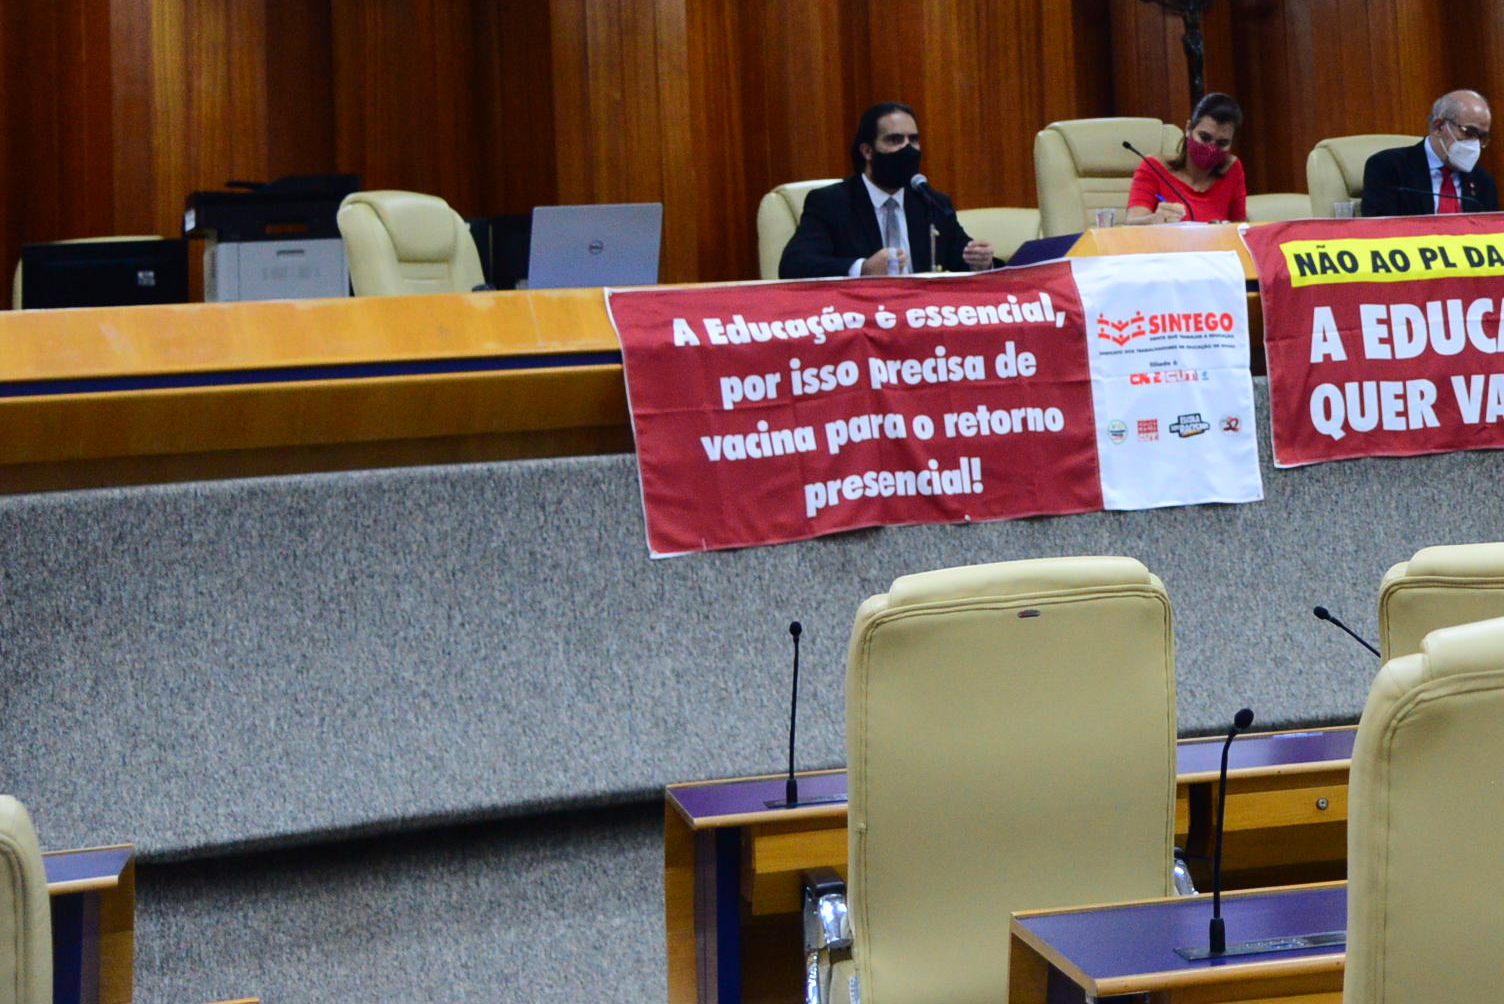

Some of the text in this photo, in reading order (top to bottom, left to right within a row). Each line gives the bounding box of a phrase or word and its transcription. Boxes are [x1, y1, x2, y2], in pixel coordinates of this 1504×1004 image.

[1292, 244, 1359, 277] NÃO
[1370, 248, 1411, 274] AO
[1418, 246, 1457, 271] PL
[672, 292, 1066, 347] A Educação é essencial,
[1149, 312, 1234, 335] SINTEGO
[1309, 306, 1348, 364] A
[720, 340, 1037, 411] por isso precisa de
[700, 404, 1065, 462] vacina para o retorno
[1309, 378, 1441, 441] QUER
[804, 456, 984, 518] presencial!
